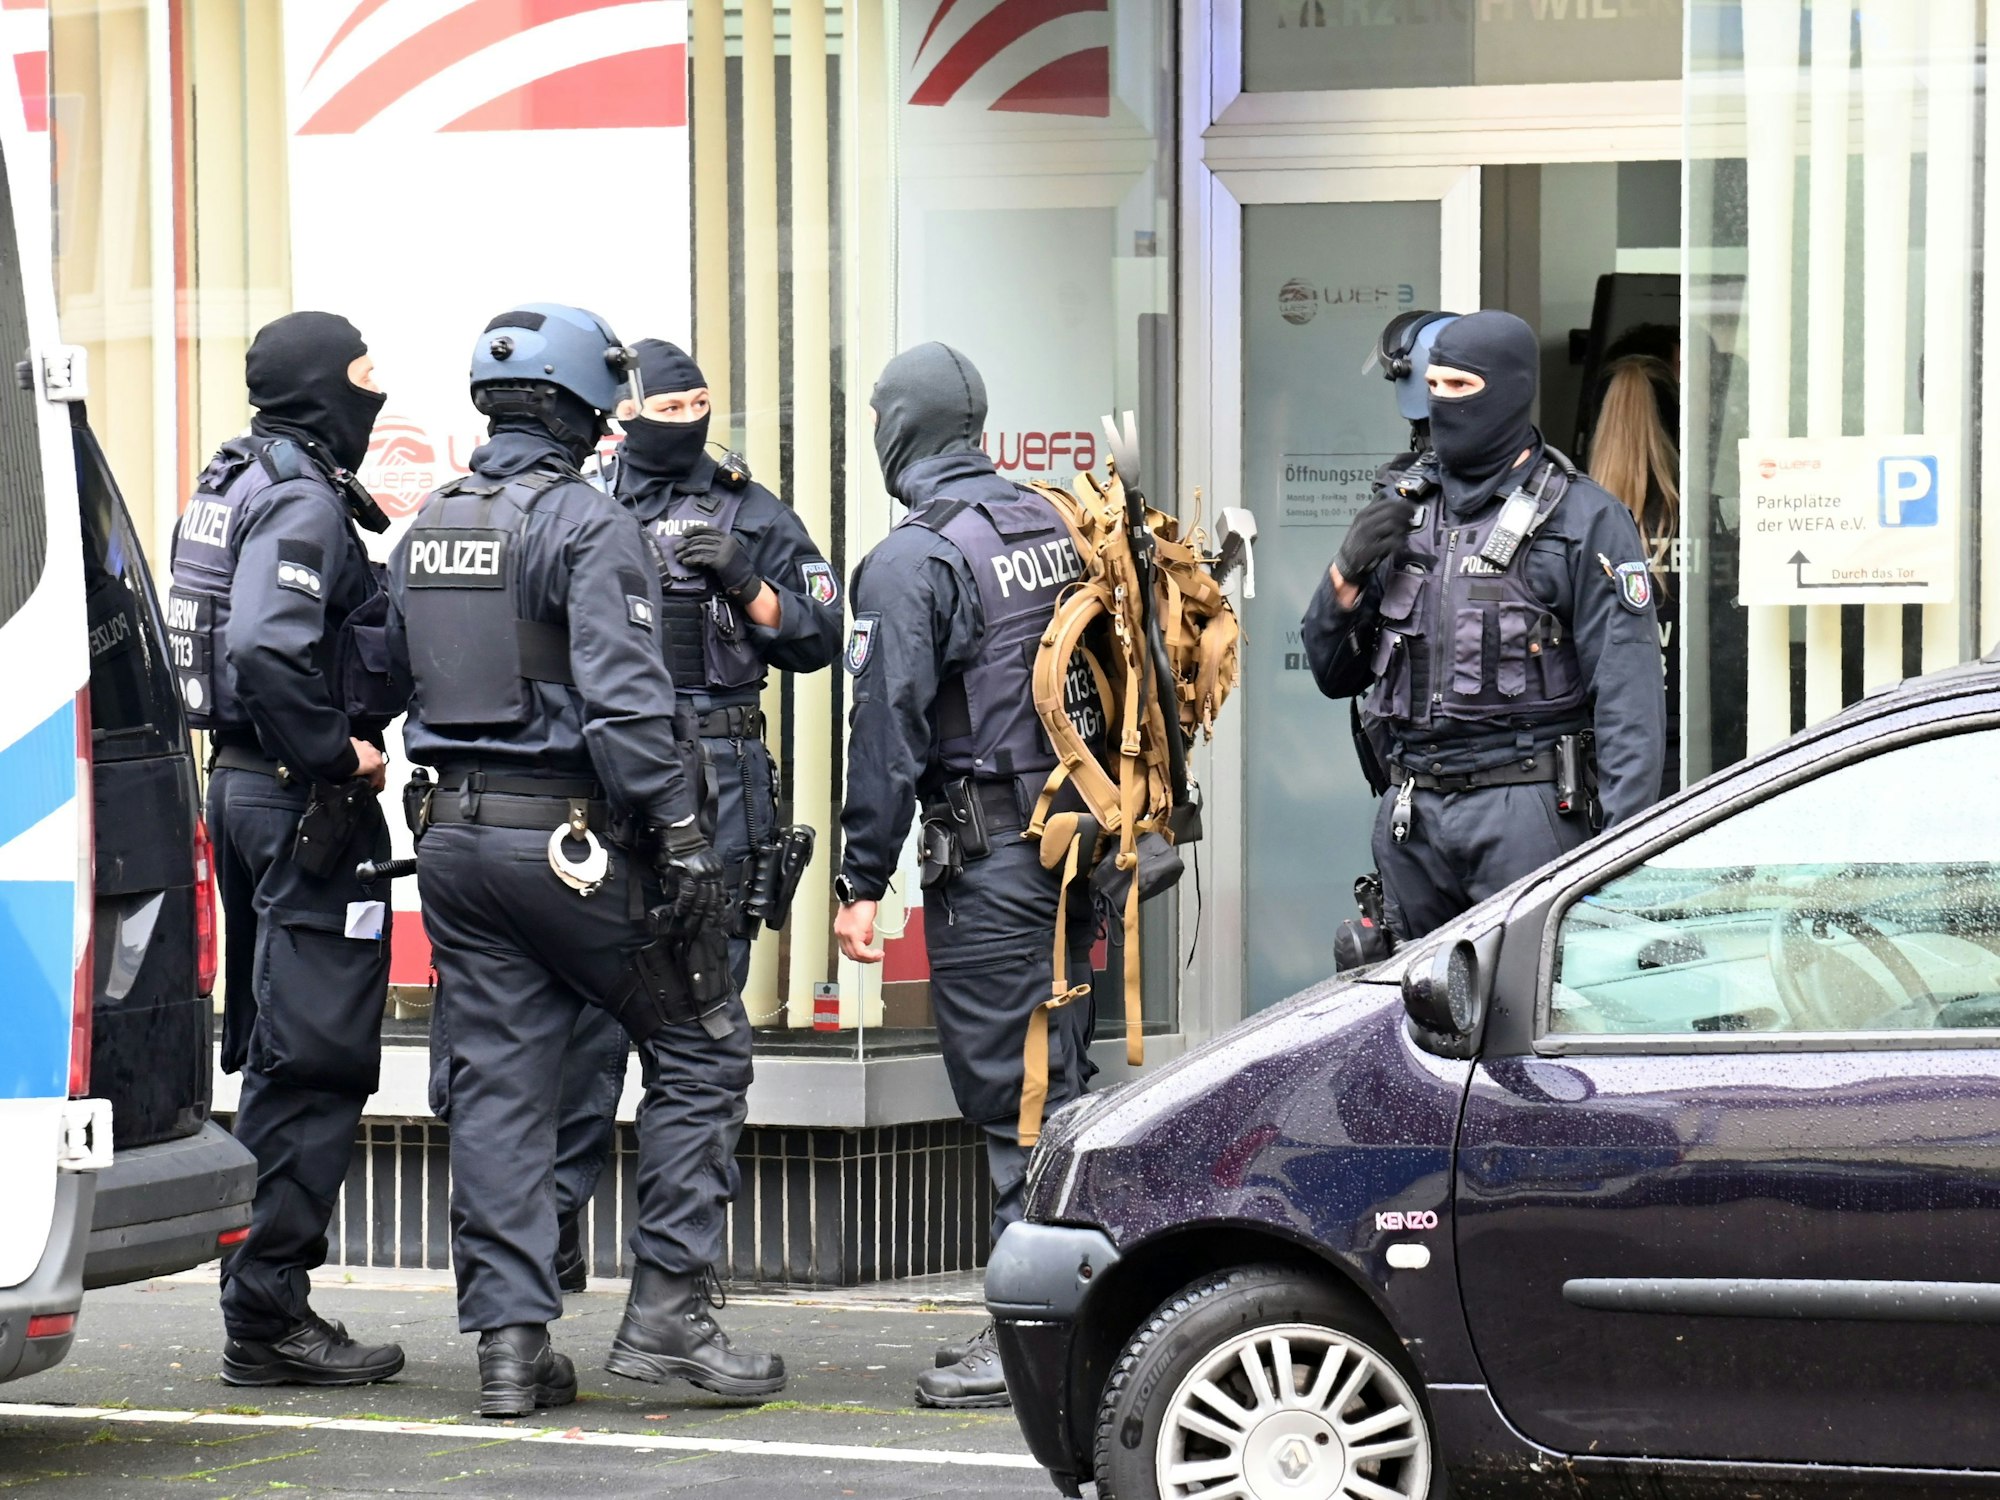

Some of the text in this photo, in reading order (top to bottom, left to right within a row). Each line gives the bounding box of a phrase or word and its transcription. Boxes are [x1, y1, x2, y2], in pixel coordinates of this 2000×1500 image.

[1285, 463, 1379, 486] Öffnungszei
[1757, 493, 1841, 511] Parkplätze
[1883, 458, 1932, 525] P
[179, 499, 232, 548] POLIZEI
[1757, 516, 1866, 532] der WEFA e.V.
[409, 541, 500, 575] POLIZEI
[991, 537, 1084, 598] POLIZEI
[1832, 567, 1915, 580] Durch das Tor
[1375, 1209, 1438, 1231] KENZO
